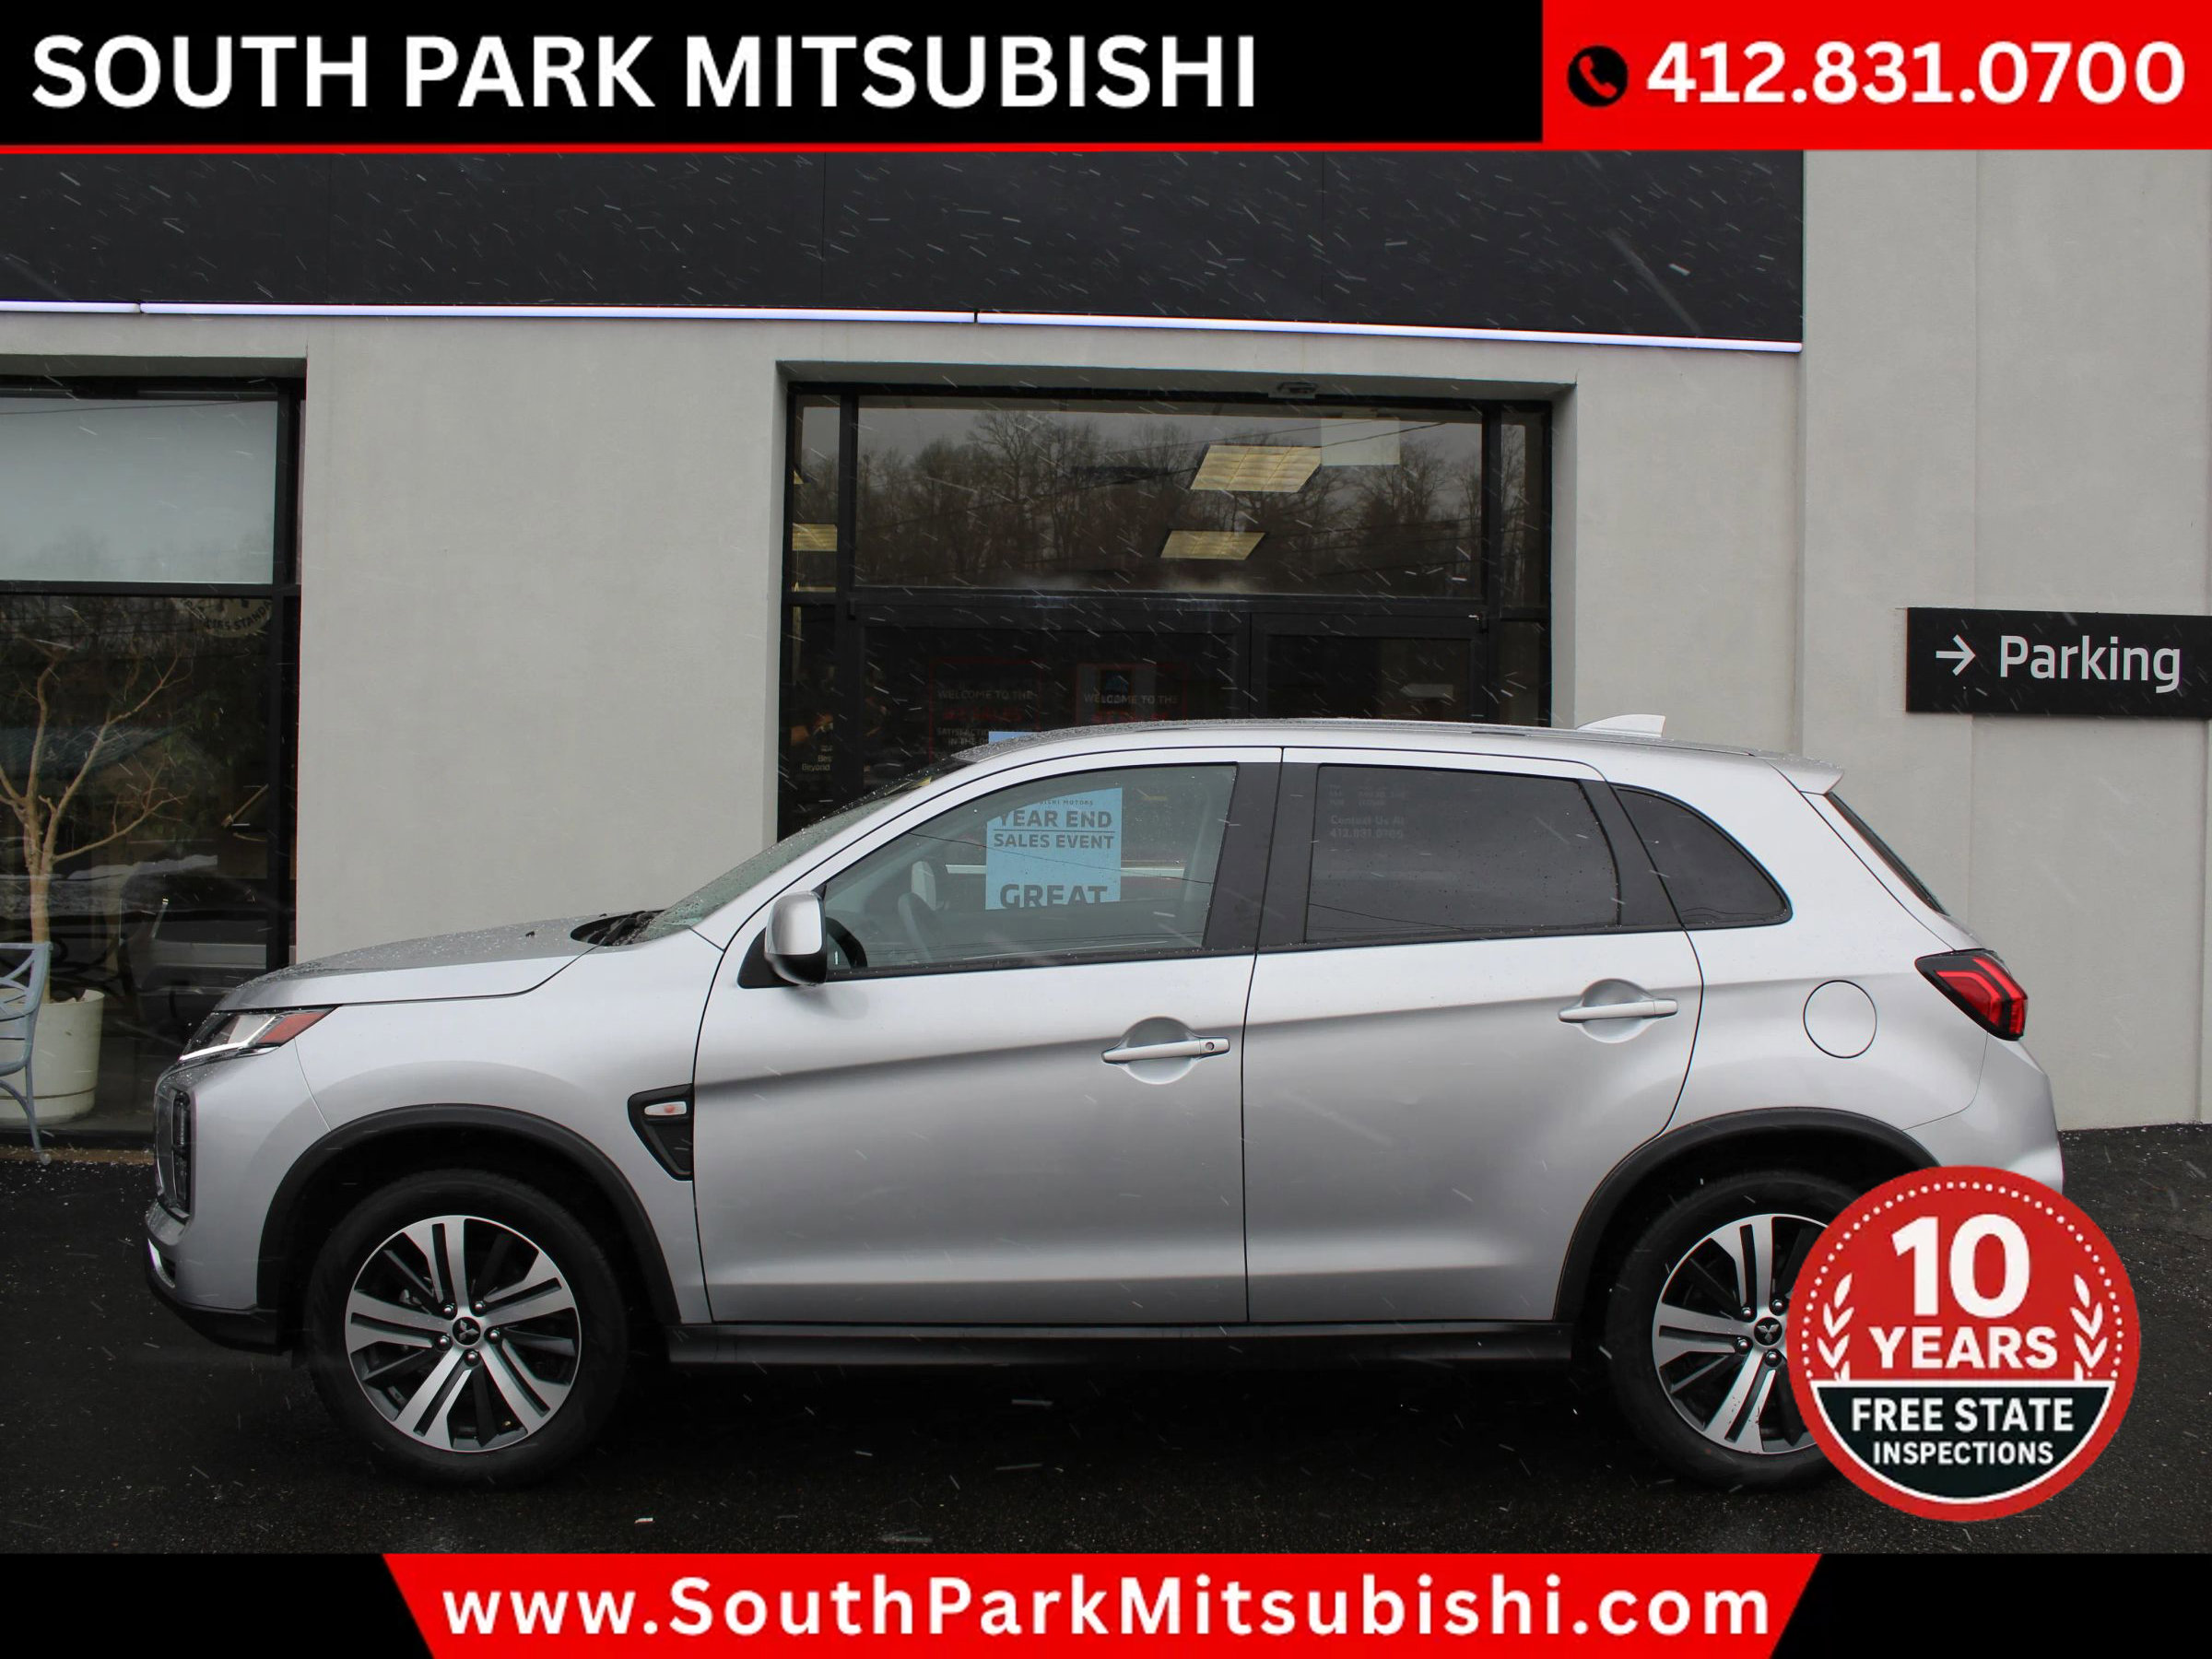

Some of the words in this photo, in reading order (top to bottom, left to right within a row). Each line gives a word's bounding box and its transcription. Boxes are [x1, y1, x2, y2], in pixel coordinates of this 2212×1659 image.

[2000, 635, 2181, 693] Parking
[938, 689, 992, 700] WELCOME
[995, 689, 1009, 700] TO
[1012, 689, 1033, 700] THE
[1084, 694, 1136, 704] WELCOME
[1141, 694, 1156, 704] TO
[1158, 695, 1181, 704] THE
[802, 763, 830, 772] Beyond
[999, 809, 1059, 827] YEAR
[1065, 810, 1112, 829] END
[994, 833, 1050, 848] SALES
[1055, 834, 1114, 849] EVENT
[999, 883, 1108, 909] GREAT
